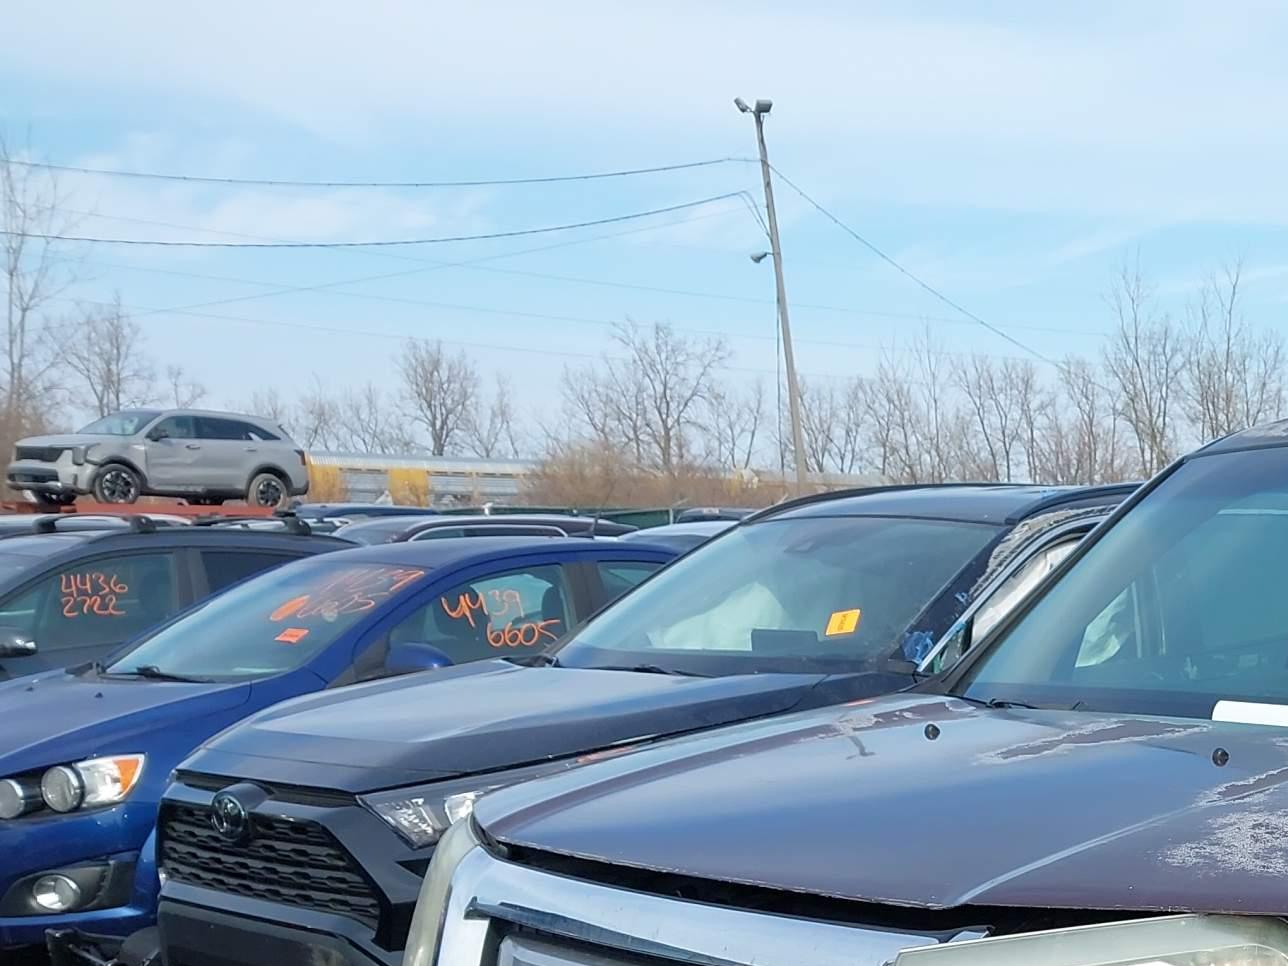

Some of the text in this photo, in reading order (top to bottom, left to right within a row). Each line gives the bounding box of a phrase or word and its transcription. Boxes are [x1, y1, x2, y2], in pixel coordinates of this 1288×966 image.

[60, 572, 129, 597] 4436
[61, 594, 127, 617] 2722
[440, 588, 525, 628] 4439
